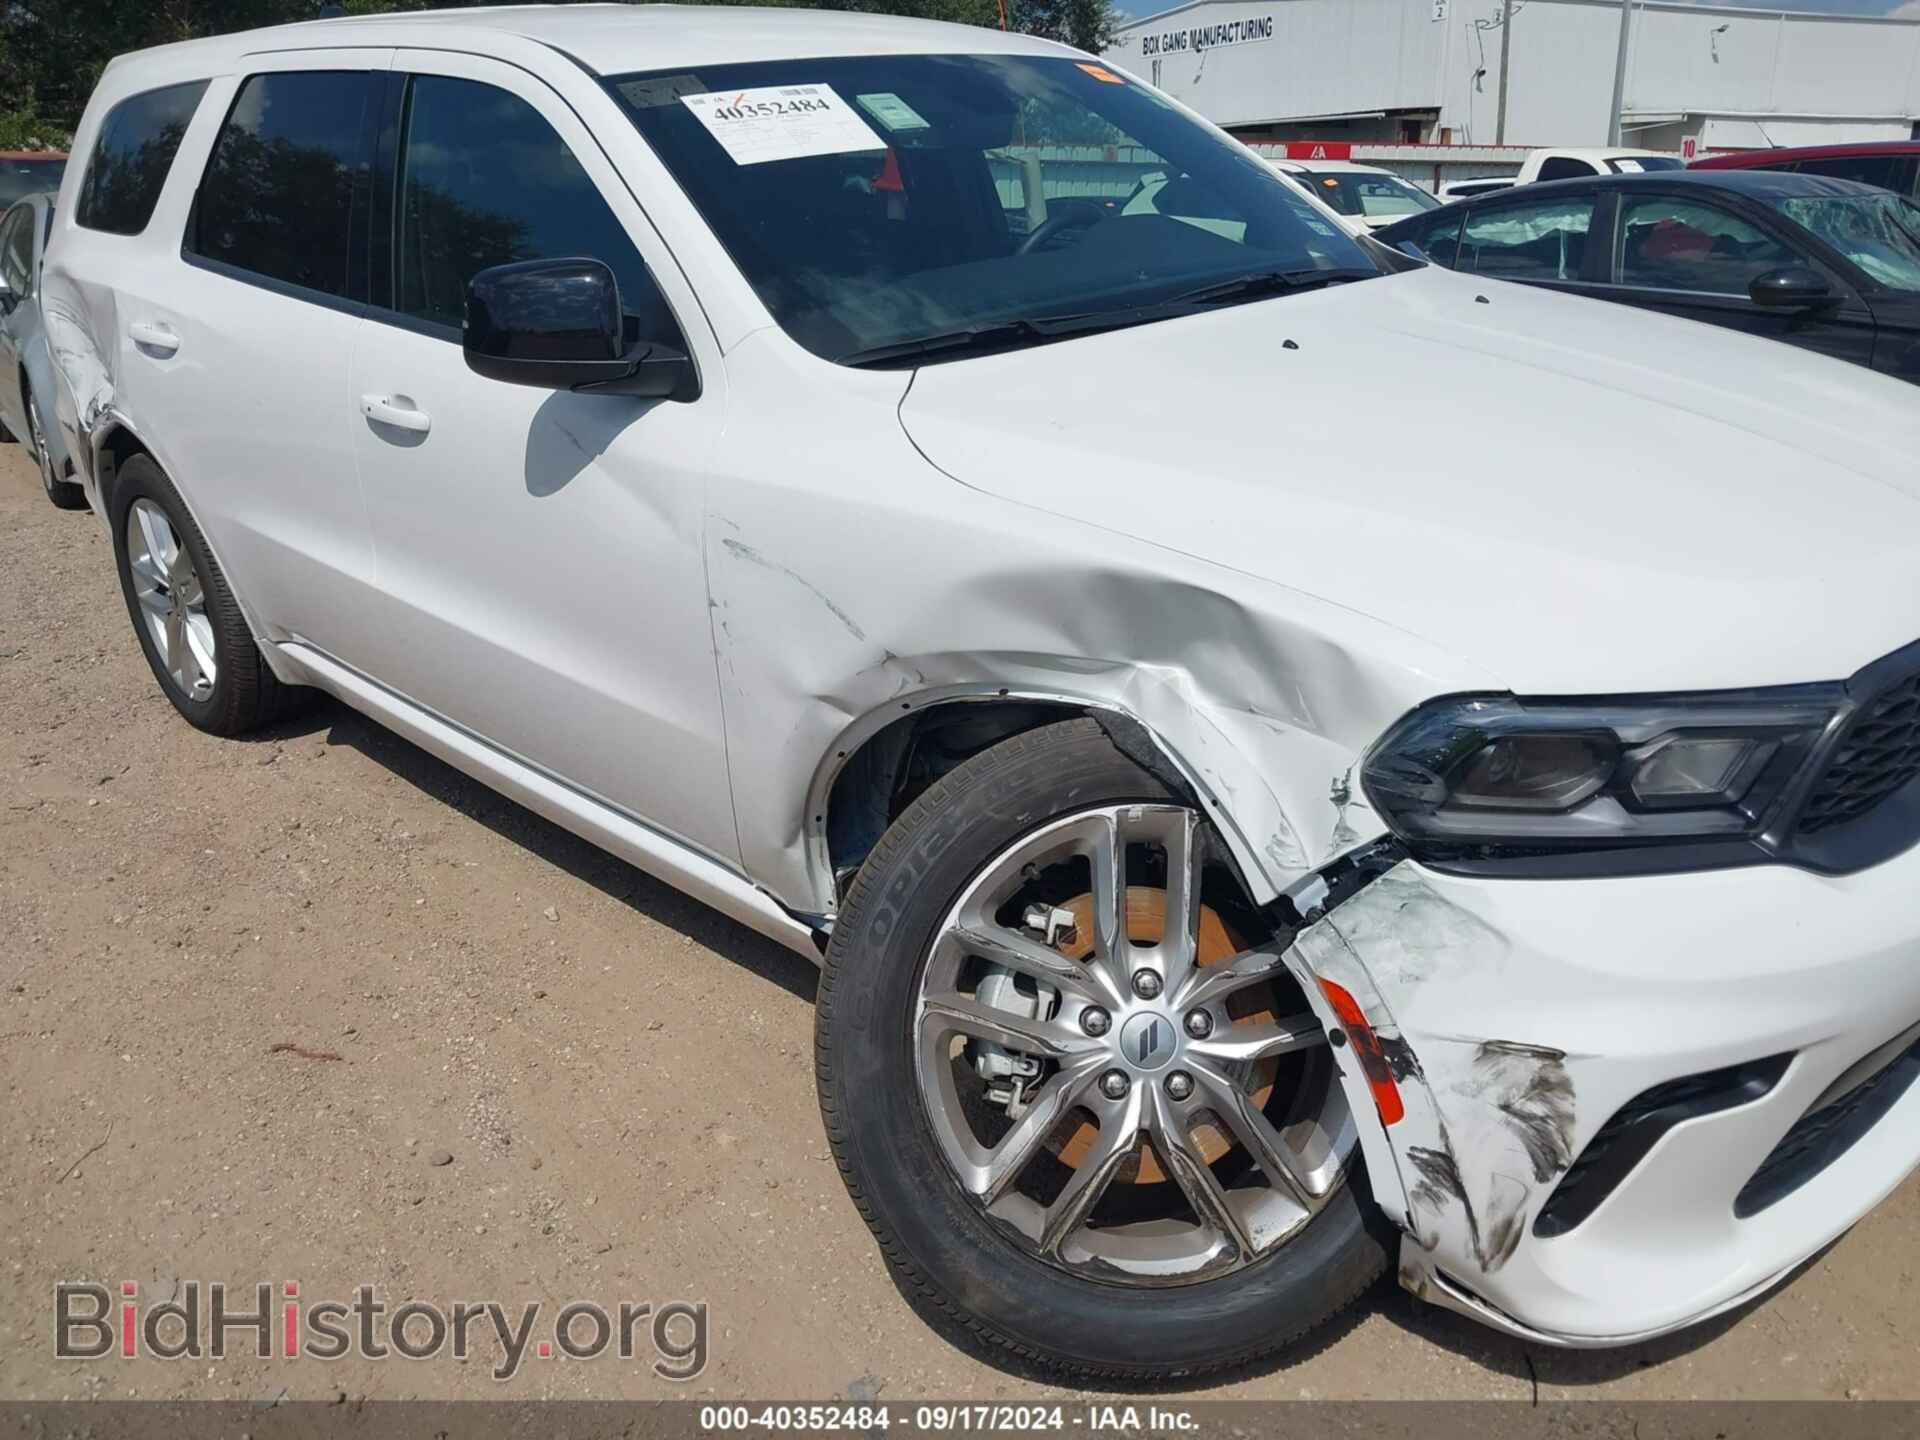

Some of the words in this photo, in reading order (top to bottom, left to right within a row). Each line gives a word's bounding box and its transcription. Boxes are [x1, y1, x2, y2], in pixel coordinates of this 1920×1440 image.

[1143, 36, 1160, 55] BOX
[1162, 30, 1187, 52] GANG
[1189, 16, 1273, 49] MANUFACTURING
[714, 99, 830, 120] 40352484
[1683, 139, 1696, 158] 10
